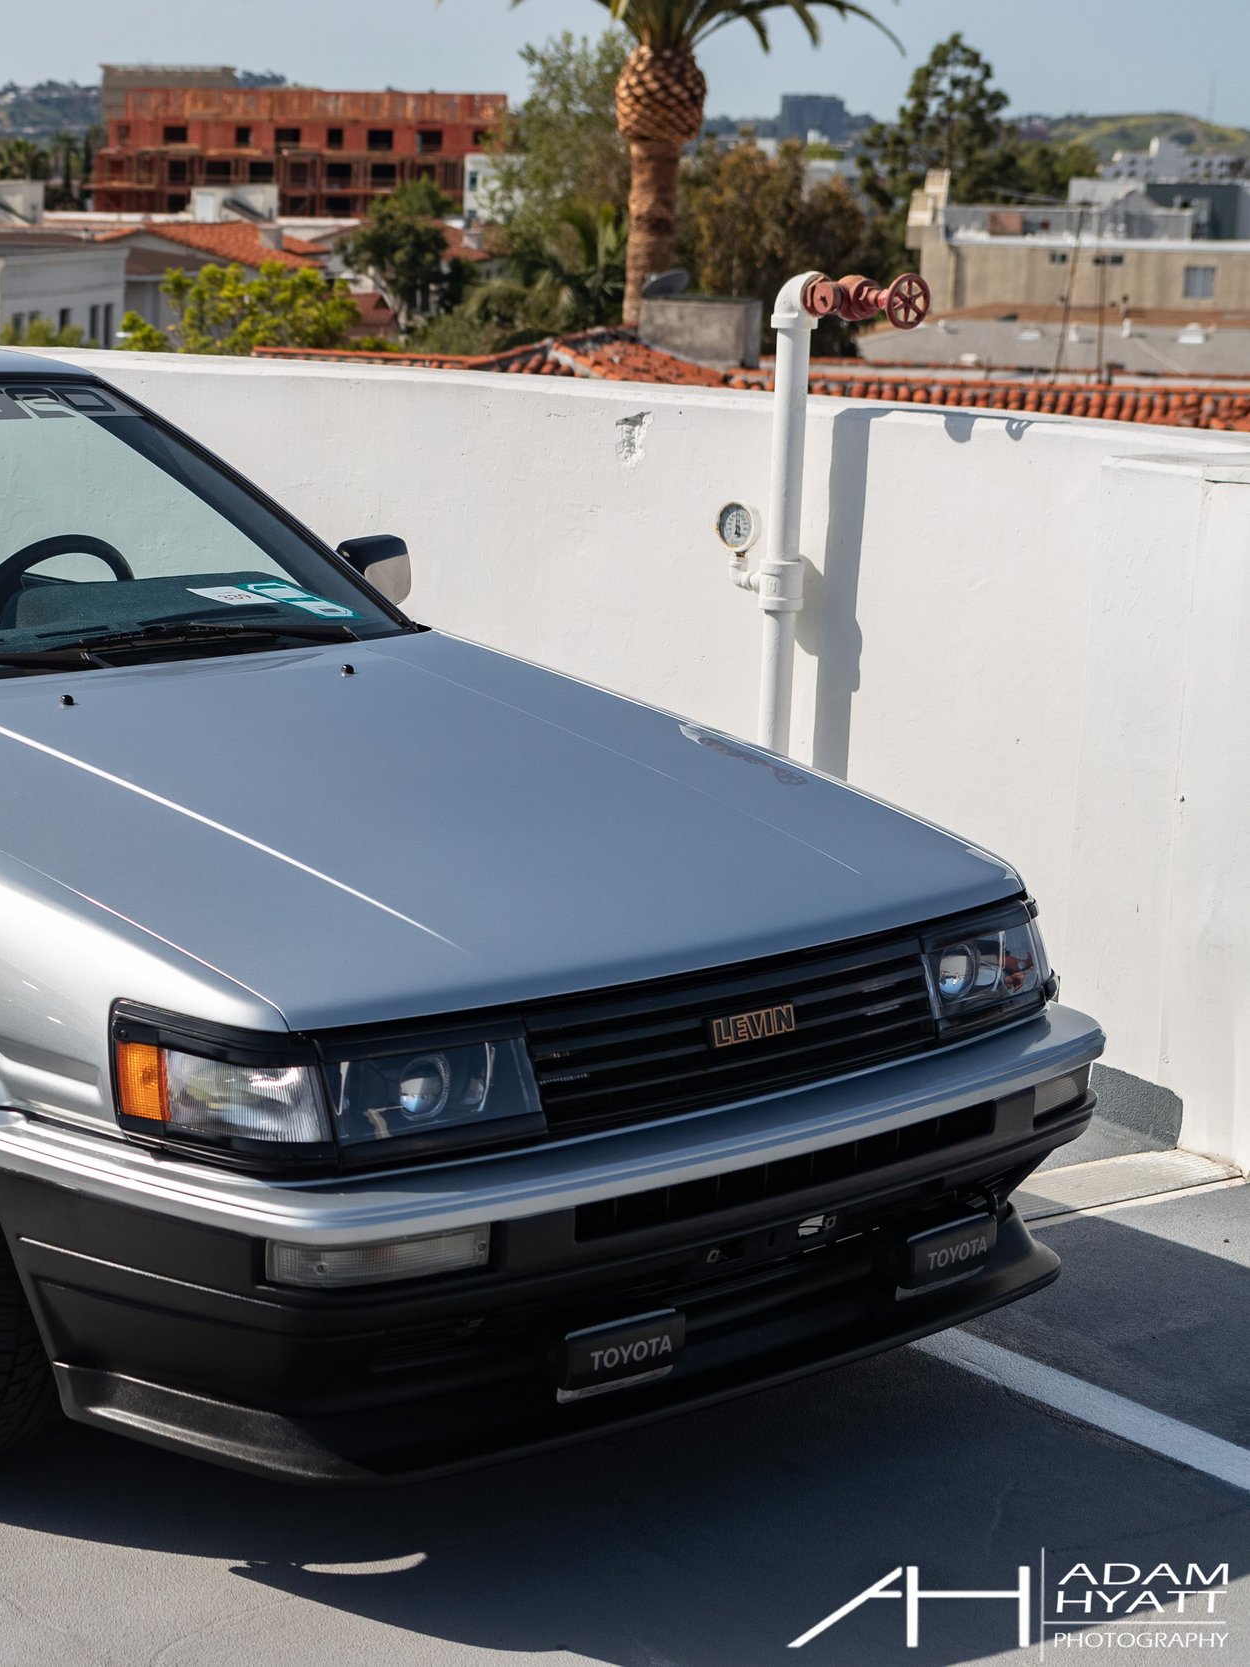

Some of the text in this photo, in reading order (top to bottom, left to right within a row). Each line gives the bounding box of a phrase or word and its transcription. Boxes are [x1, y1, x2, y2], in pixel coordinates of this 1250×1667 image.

[712, 1003, 796, 1048] LEVIN
[927, 1236, 988, 1271] TOYOTA
[590, 1334, 672, 1371] TOYOTA
